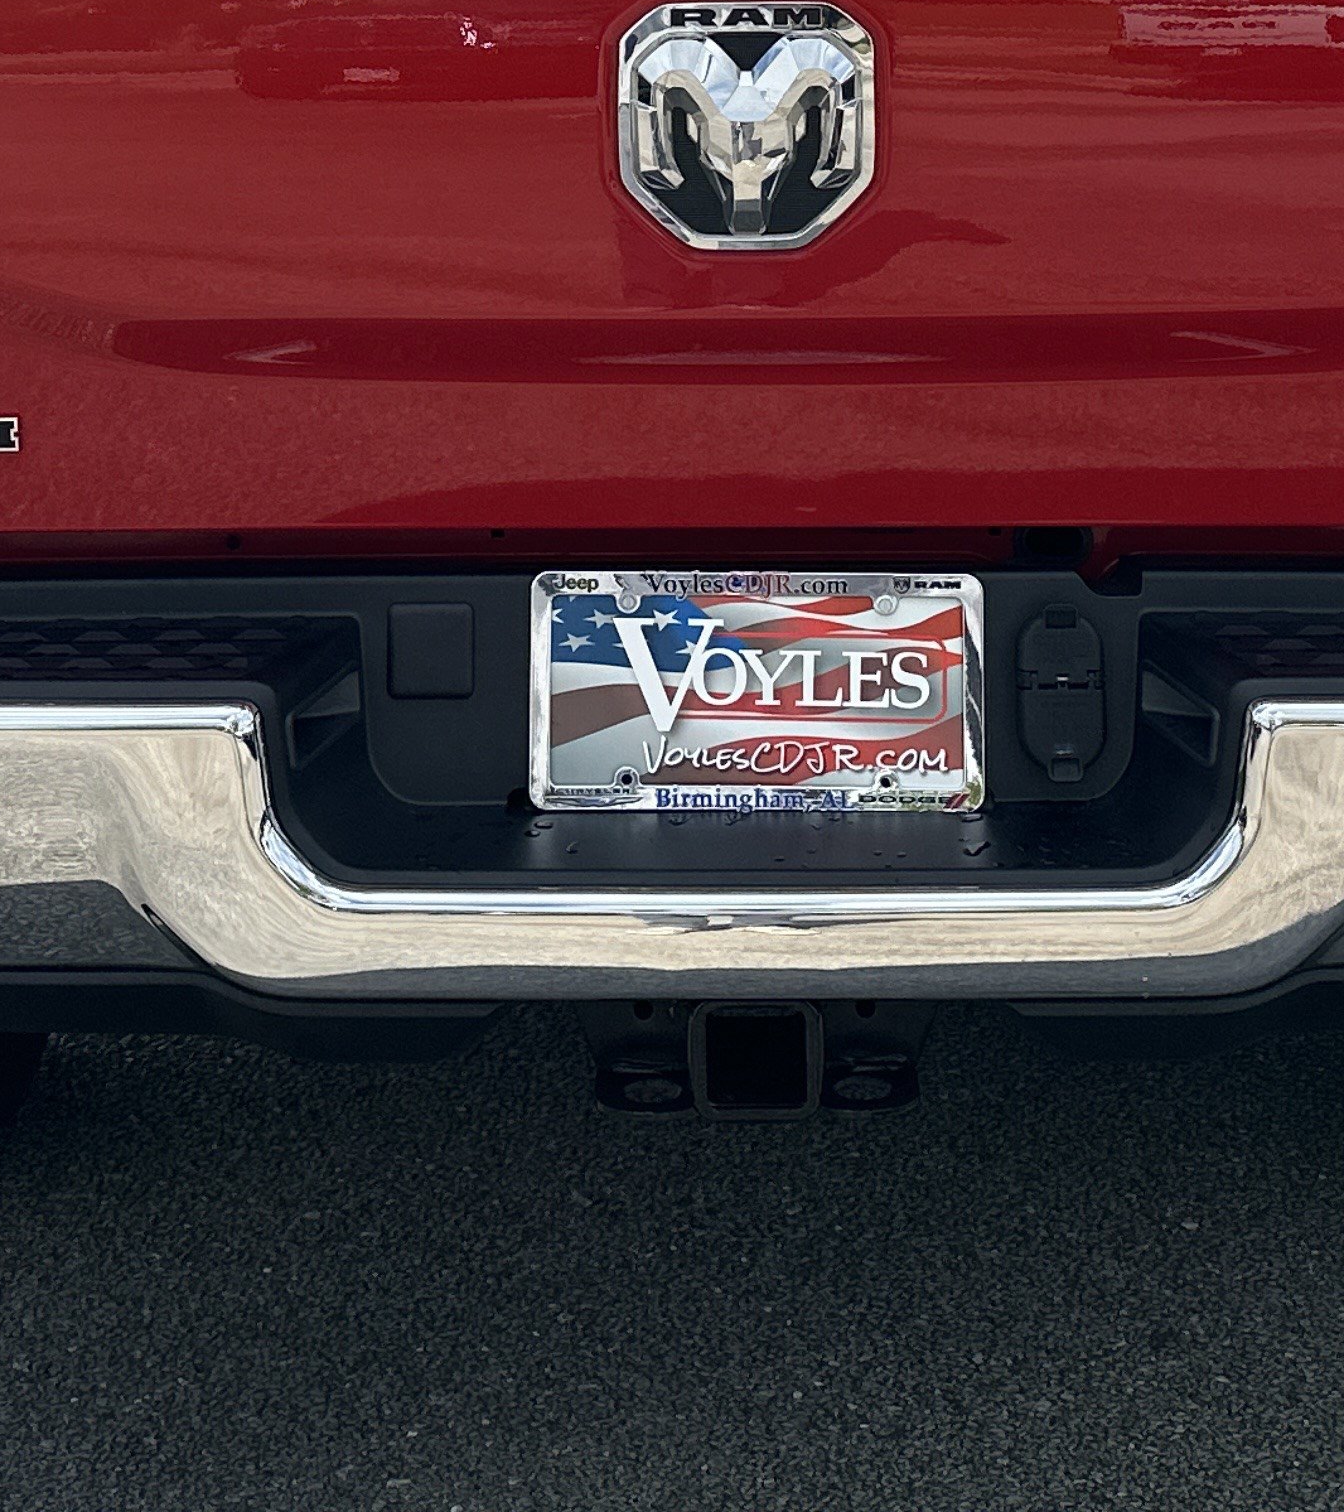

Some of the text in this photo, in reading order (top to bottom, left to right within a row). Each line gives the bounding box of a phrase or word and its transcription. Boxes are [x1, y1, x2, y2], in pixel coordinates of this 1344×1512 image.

[670, 7, 822, 28] RAM
[556, 573, 600, 593] Jeep
[642, 573, 849, 600] VoylesCDJR.com
[913, 580, 962, 590] RAM
[612, 617, 931, 732] VOYLES
[655, 787, 856, 814] Birmingham, AL
[858, 794, 953, 805] DODGE
